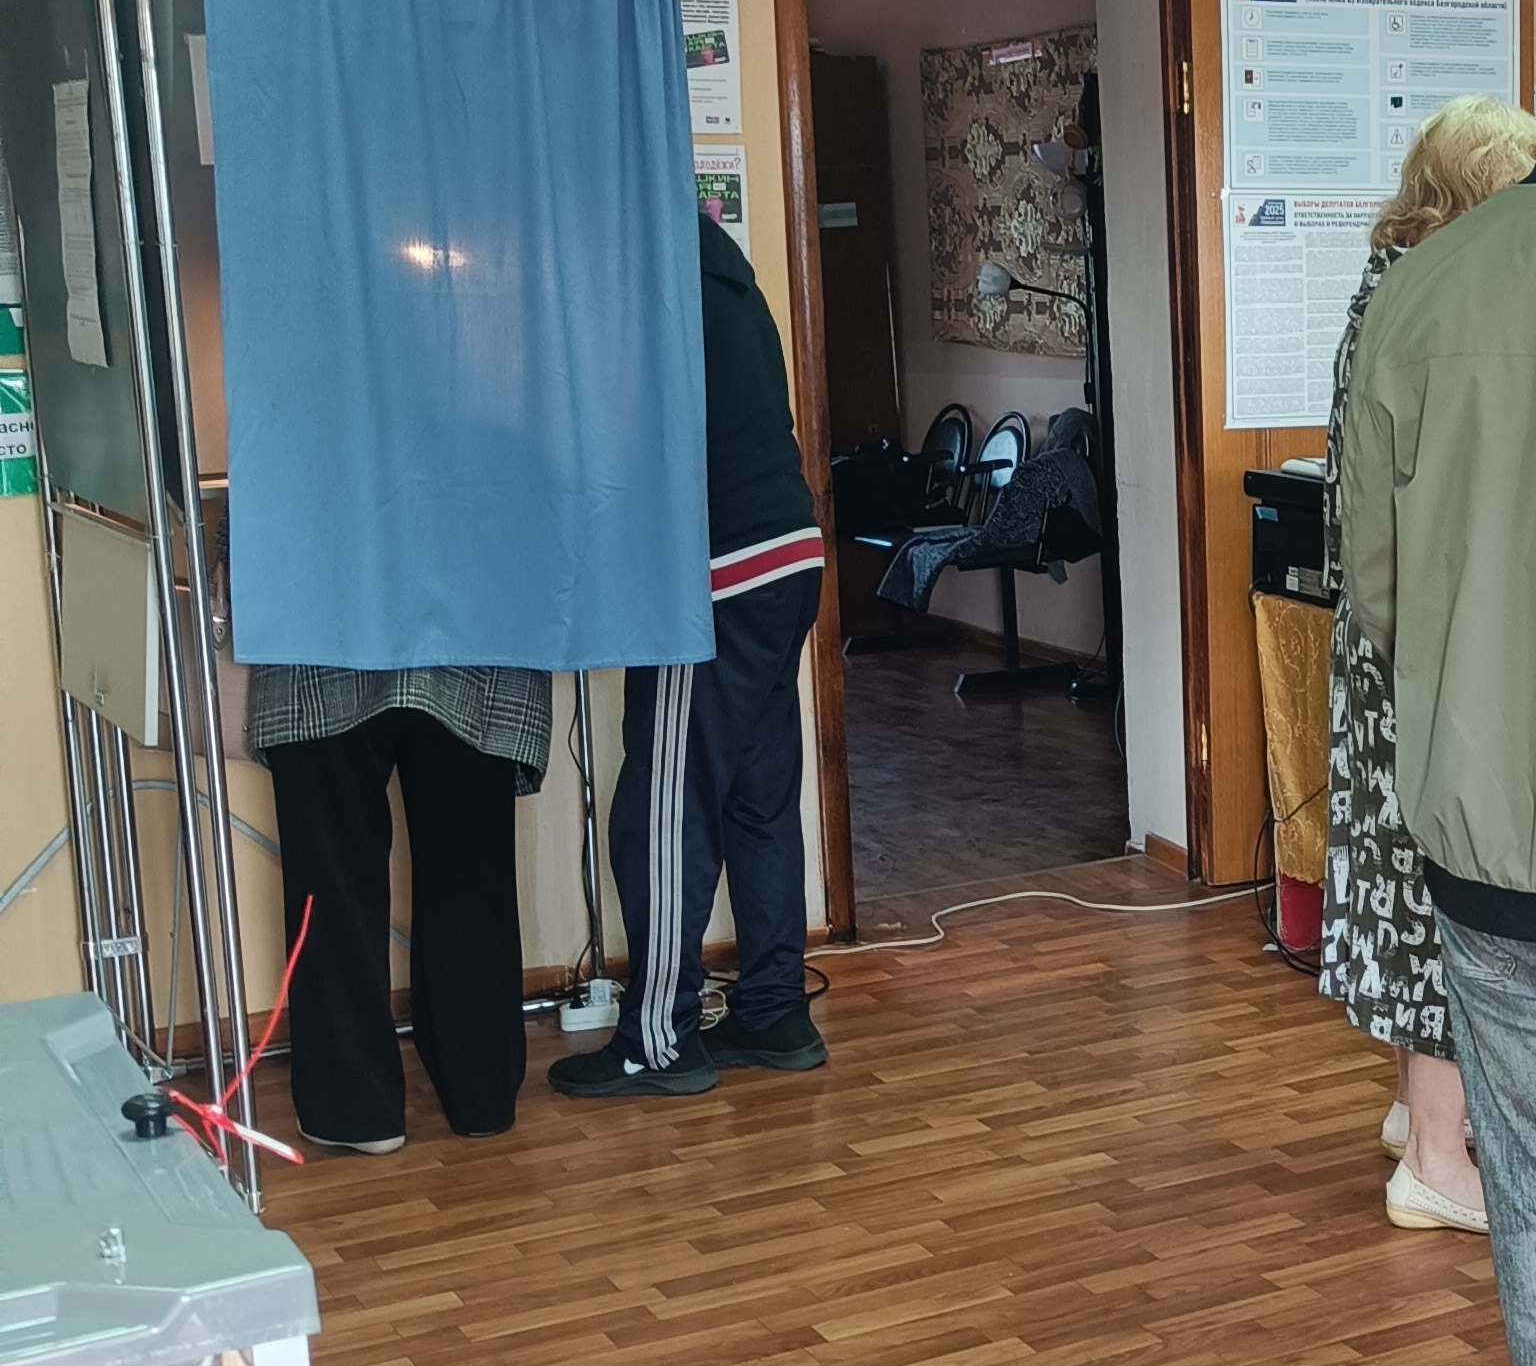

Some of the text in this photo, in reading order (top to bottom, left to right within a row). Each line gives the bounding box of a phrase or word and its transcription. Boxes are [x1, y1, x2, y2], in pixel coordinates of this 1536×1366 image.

[1293, 200, 1320, 208] ВЫБОРЫ
[1321, 201, 1354, 209] ДЕПУТАТОВ
[1264, 205, 1285, 216] 2025
